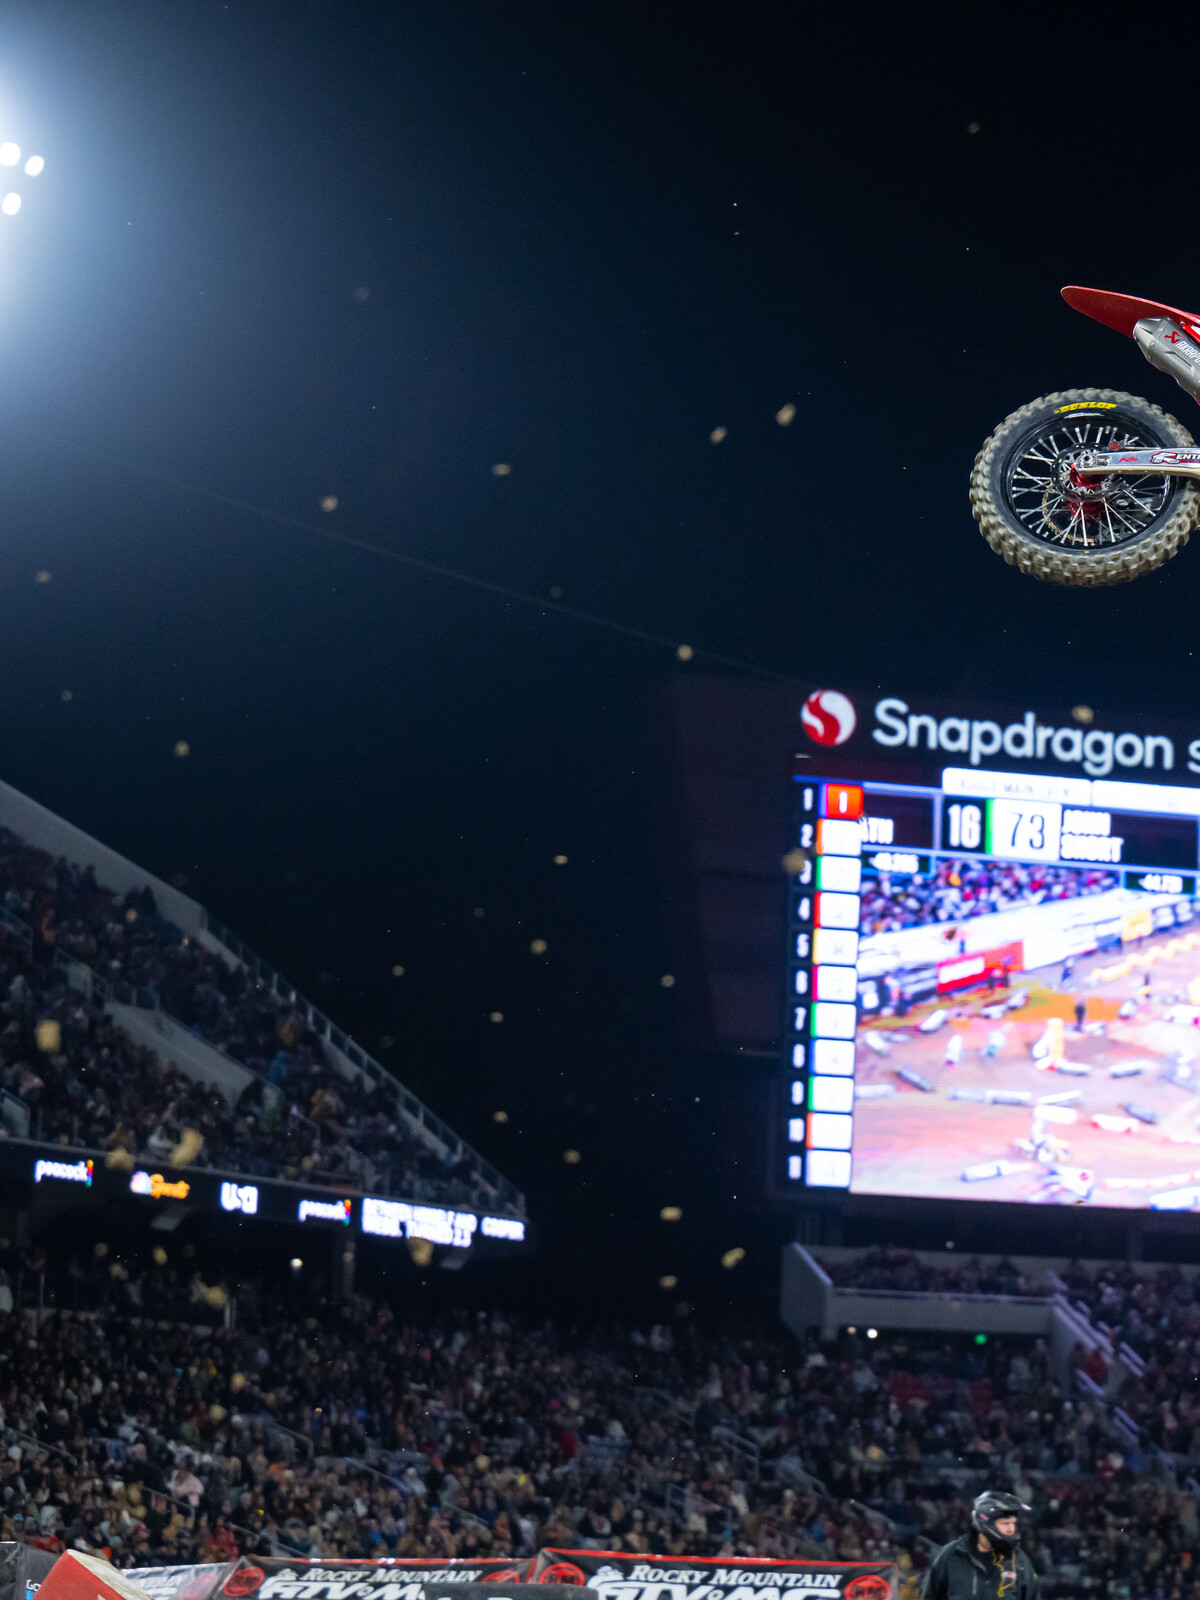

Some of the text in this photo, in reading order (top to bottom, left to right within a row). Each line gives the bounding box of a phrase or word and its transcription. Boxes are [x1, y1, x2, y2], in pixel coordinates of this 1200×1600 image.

[1059, 402, 1117, 413] DUNLOP
[873, 698, 1174, 777] Snapdragon
[803, 788, 813, 811] 1
[801, 824, 812, 848] 2
[948, 804, 981, 848] 16
[1010, 812, 1046, 850] 73
[794, 1007, 807, 1031] 7
[35, 1160, 88, 1183] peacock
[298, 1199, 347, 1222] peacock
[303, 1568, 483, 1583] ROCKY MOUNTAIN
[627, 1564, 843, 1588] ROCKY MOUNTAIN
